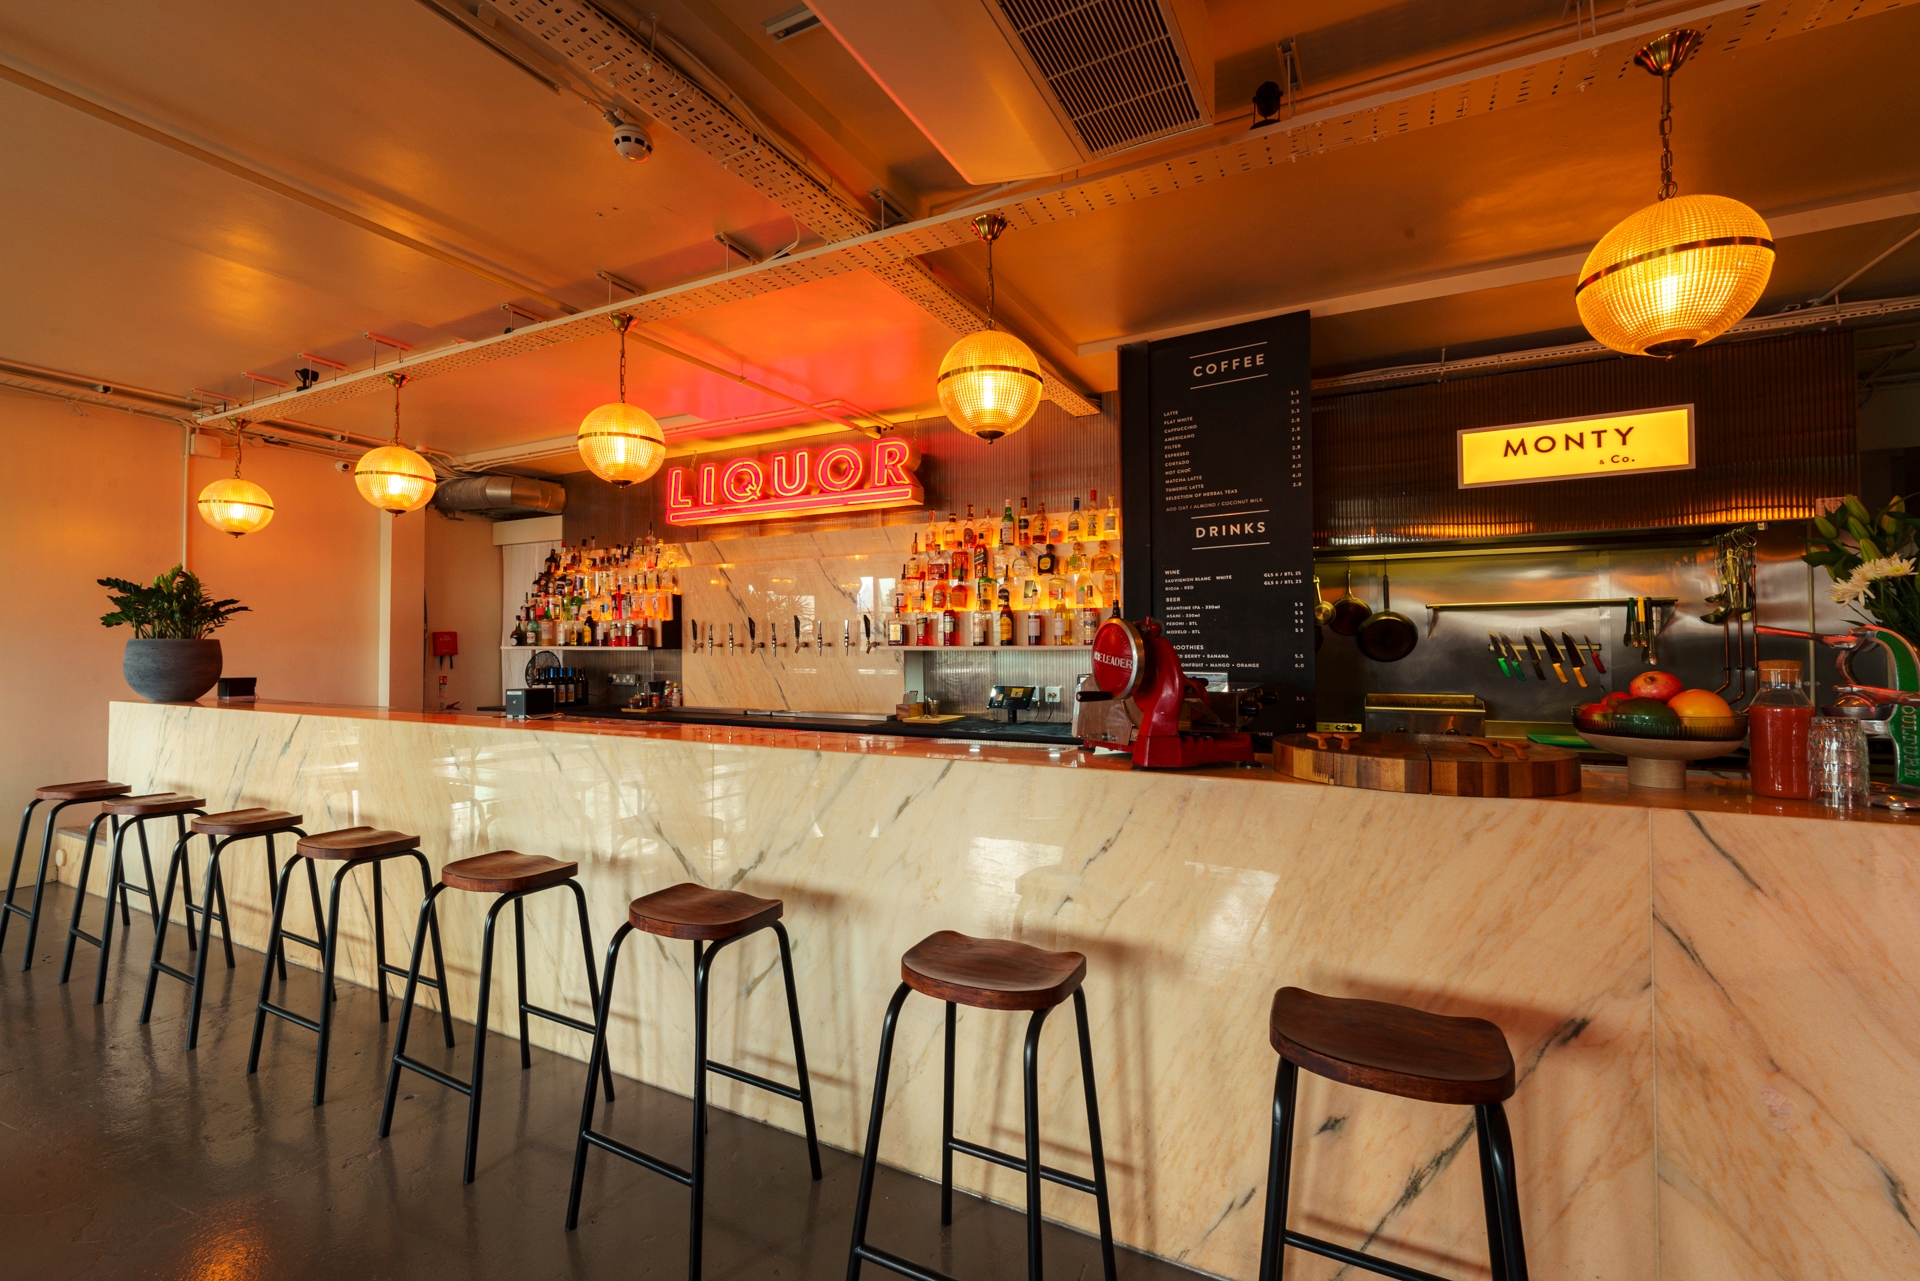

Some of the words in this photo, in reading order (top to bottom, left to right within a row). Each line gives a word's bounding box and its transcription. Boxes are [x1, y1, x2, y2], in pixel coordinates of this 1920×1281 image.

[1193, 353, 1265, 377] COFFEE
[1164, 424, 1198, 433] CAPPUCCINO
[1164, 433, 1195, 442] AMERICANO
[1503, 427, 1634, 457] MONTY
[1165, 451, 1190, 459] ESPRESSO
[1611, 454, 1635, 463] Co.
[1165, 459, 1190, 467] CORTADO
[668, 437, 911, 508] LIQUOR
[1221, 498, 1249, 506] COCONUT
[1196, 521, 1266, 538] DRINKS
